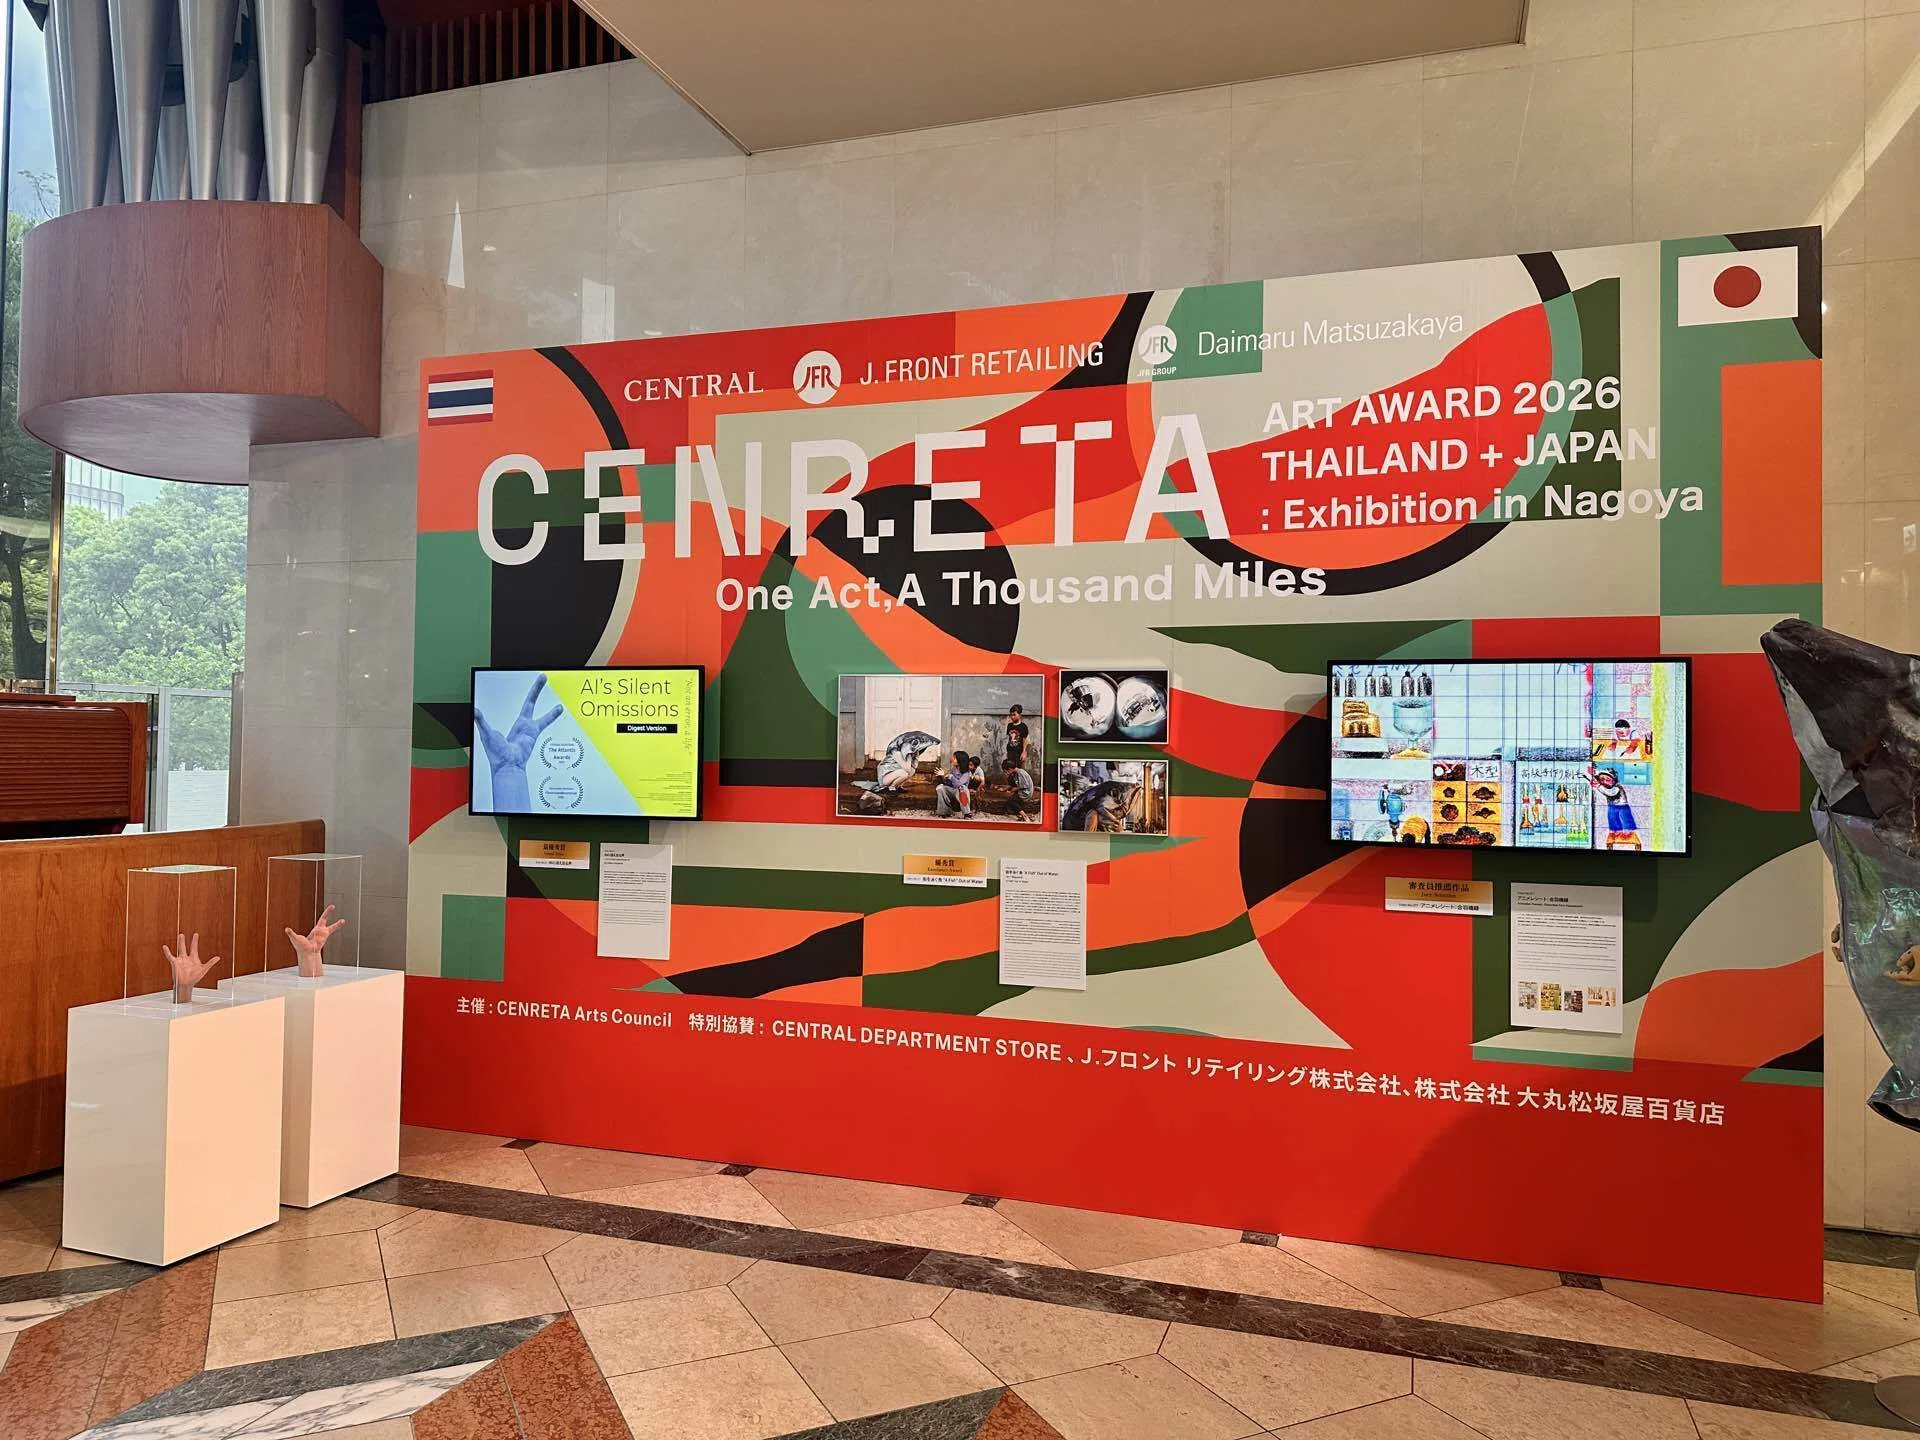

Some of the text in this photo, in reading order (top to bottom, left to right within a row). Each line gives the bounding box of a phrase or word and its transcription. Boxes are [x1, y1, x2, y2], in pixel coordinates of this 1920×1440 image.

[1198, 313, 1464, 356] Daimaru Matsuzakaya
[860, 362, 878, 385] J.
[885, 354, 965, 382] FRONT
[971, 341, 1104, 376] RETAILING
[1152, 366, 1177, 376] GROUP
[623, 371, 764, 402] CENTRAL
[1262, 375, 1621, 433] ART AWARD 2026
[1261, 438, 1469, 481] THAILAND
[1513, 426, 1657, 467] JAPAN
[477, 413, 1231, 566] CENRETA
[1283, 489, 1477, 530] Exhibition
[1493, 487, 1527, 519] in
[1544, 485, 1704, 521] Nagoya
[716, 577, 793, 612] One
[942, 564, 1172, 606] Thousand
[1194, 561, 1327, 600] Miles
[618, 677, 671, 695] Silent
[581, 700, 679, 717] Omissions
[1471, 765, 1498, 779] 木型
[497, 1000, 570, 1020] CENRETA
[574, 1005, 608, 1023] Arts
[611, 1008, 673, 1027] Council
[772, 1020, 856, 1043] CENTRAL
[861, 1027, 990, 1055] DEPARTMENT
[1517, 1089, 1725, 1126] 大丸松坂屋百貨店
